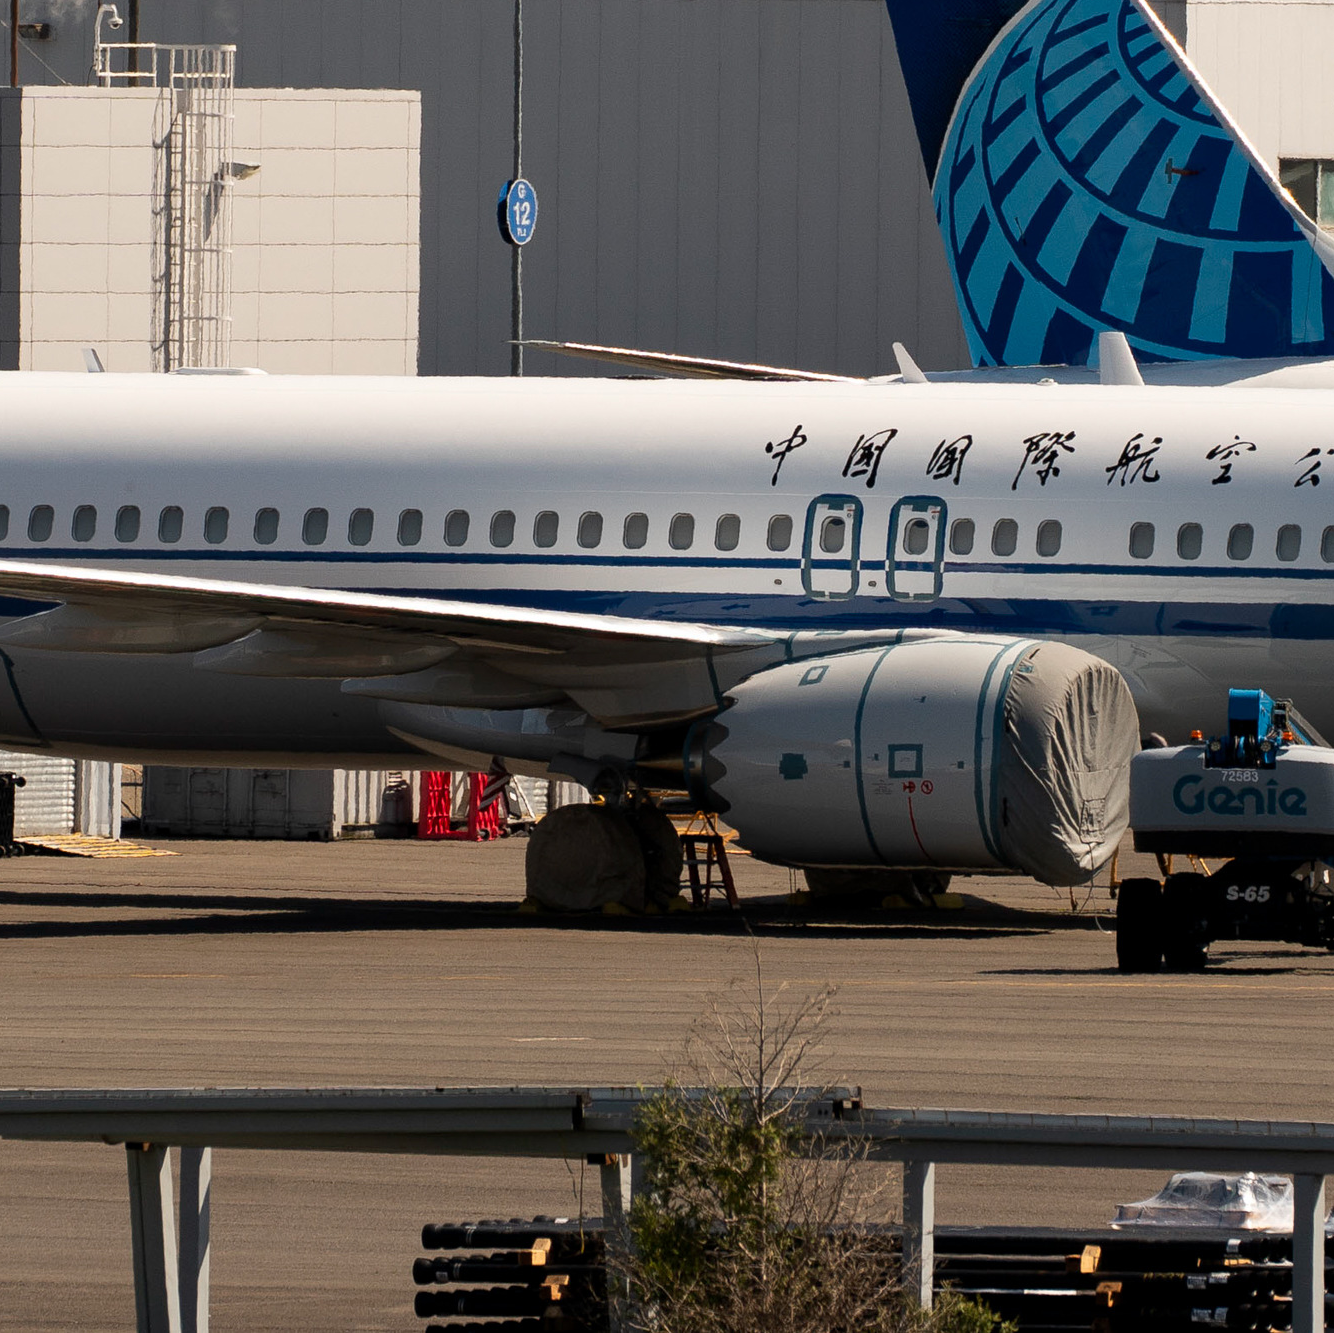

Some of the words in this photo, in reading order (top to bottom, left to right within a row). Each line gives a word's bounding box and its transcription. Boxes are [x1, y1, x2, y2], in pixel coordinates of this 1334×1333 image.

[517, 183, 527, 199] G
[513, 201, 531, 225] 12
[1222, 770, 1259, 782] 72583
[1173, 774, 1307, 815] Genie
[1226, 886, 1270, 902] S-65
